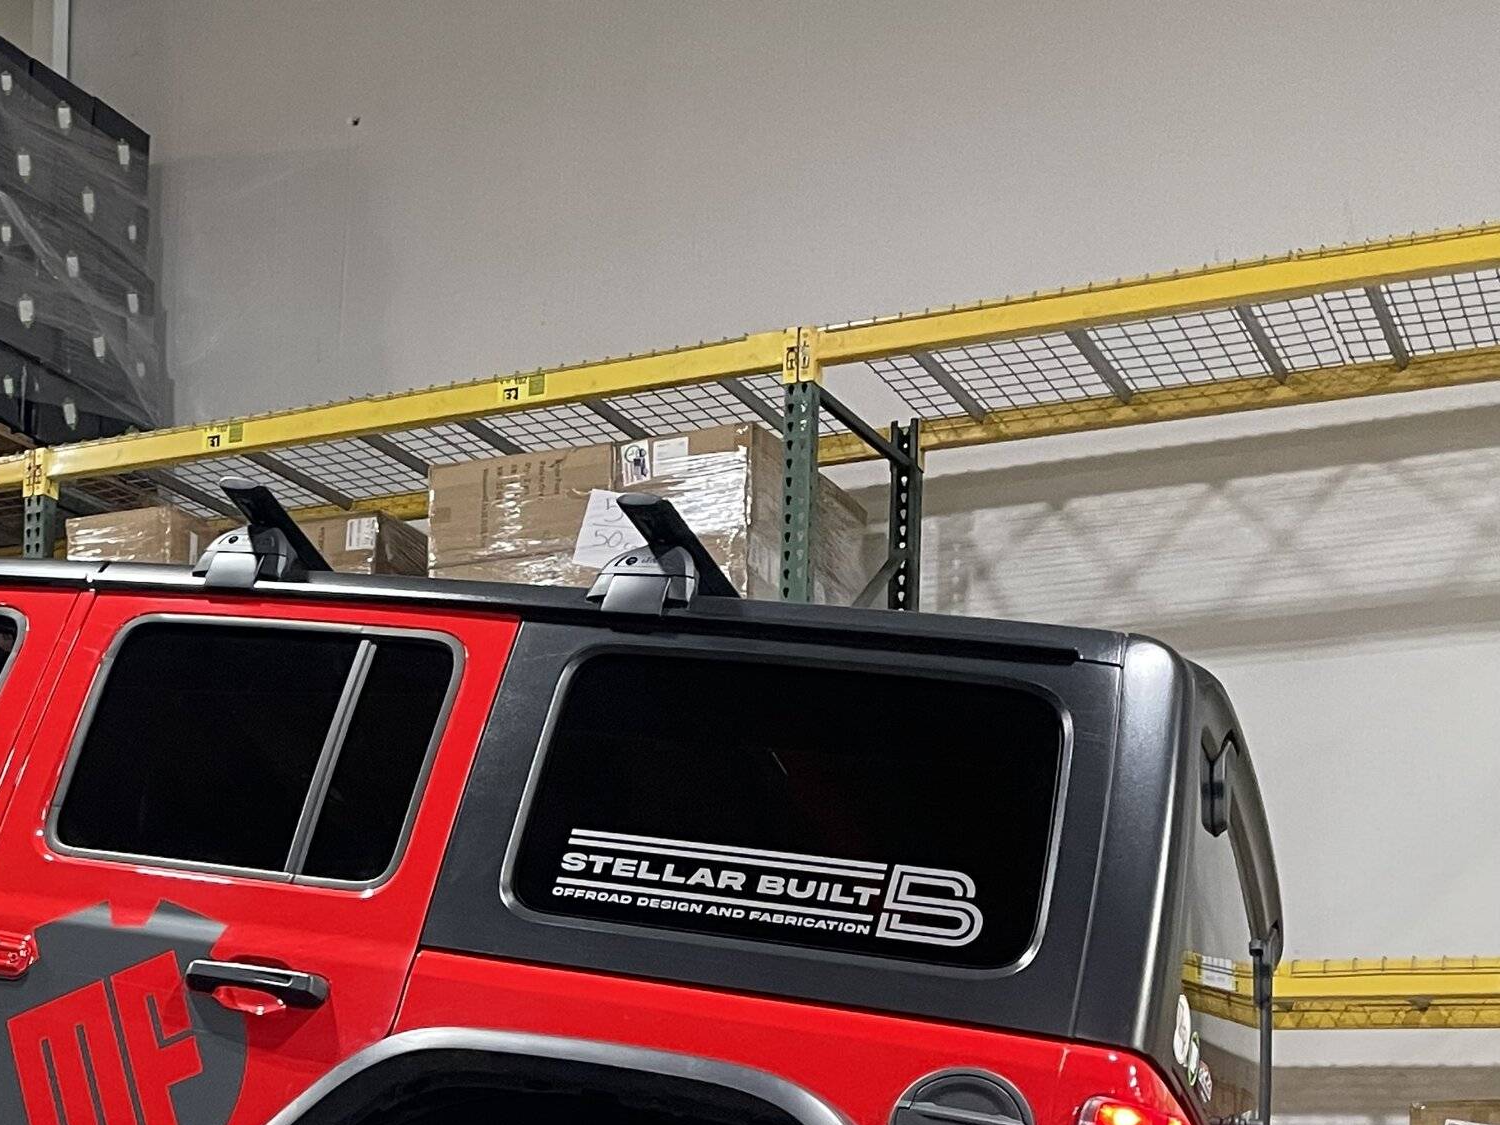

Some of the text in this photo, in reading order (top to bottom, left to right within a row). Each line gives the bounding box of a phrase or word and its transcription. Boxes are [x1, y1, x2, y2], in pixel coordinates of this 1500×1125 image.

[561, 852, 881, 907] STELLAR BUILT
[552, 886, 871, 935] OFFROAD DESIGN AND FABRICATION
